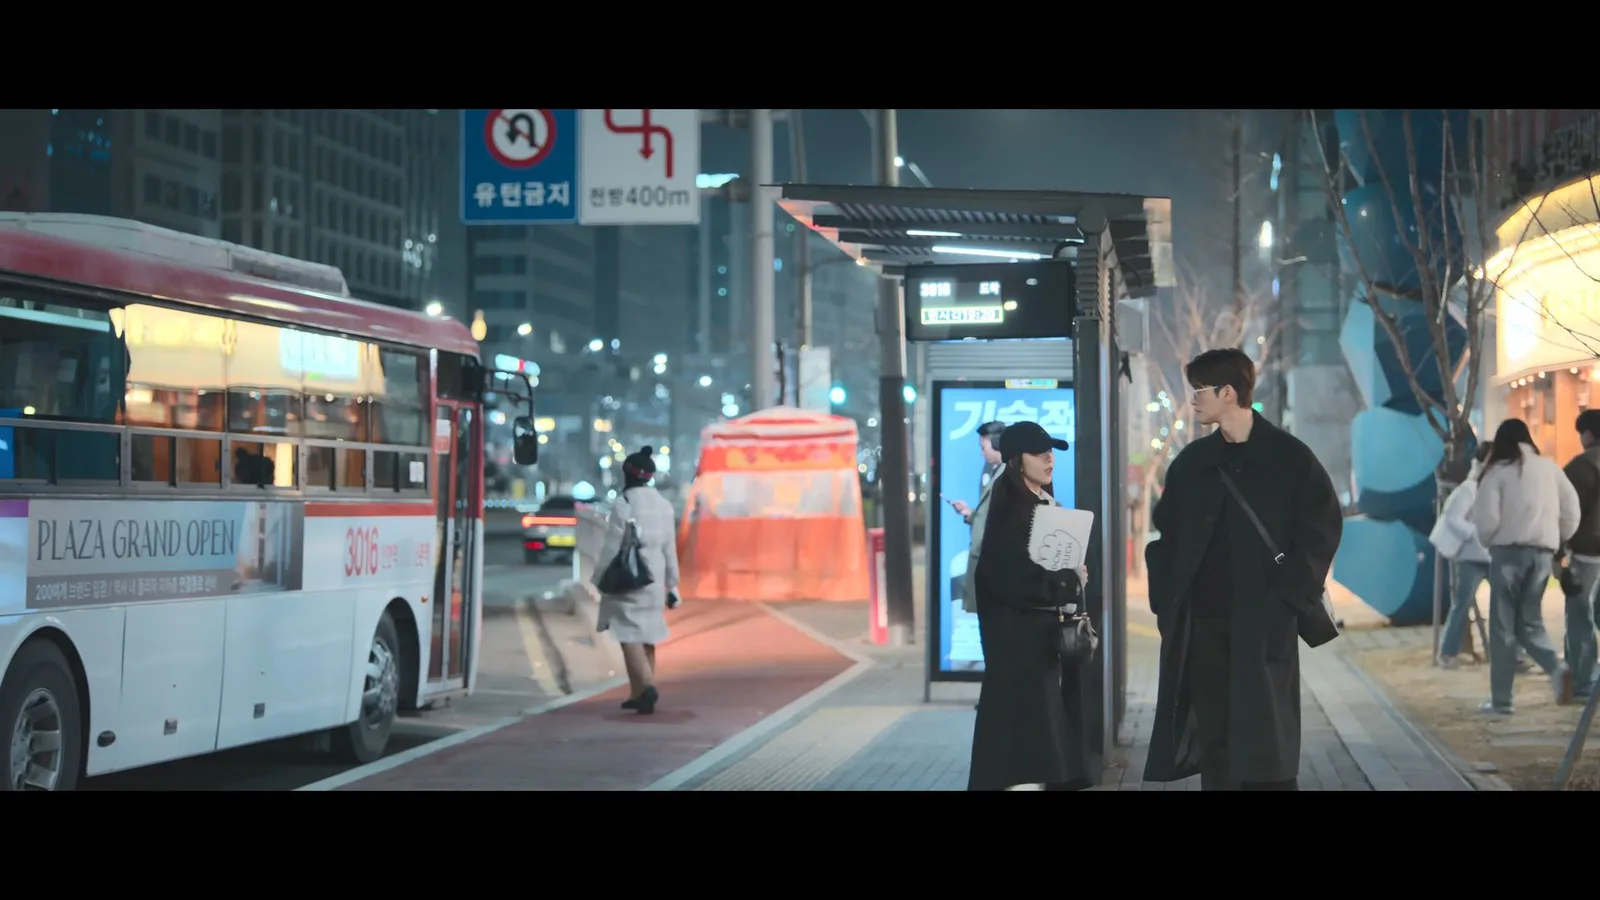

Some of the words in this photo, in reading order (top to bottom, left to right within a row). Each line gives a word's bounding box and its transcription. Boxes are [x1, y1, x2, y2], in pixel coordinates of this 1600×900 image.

[473, 181, 570, 208] 유턴금지
[36, 518, 106, 561] PLAZA
[112, 518, 182, 559] GRAND
[186, 518, 235, 557] OPEN
[345, 527, 378, 576] 3016
[1061, 542, 1072, 568] OUCH
